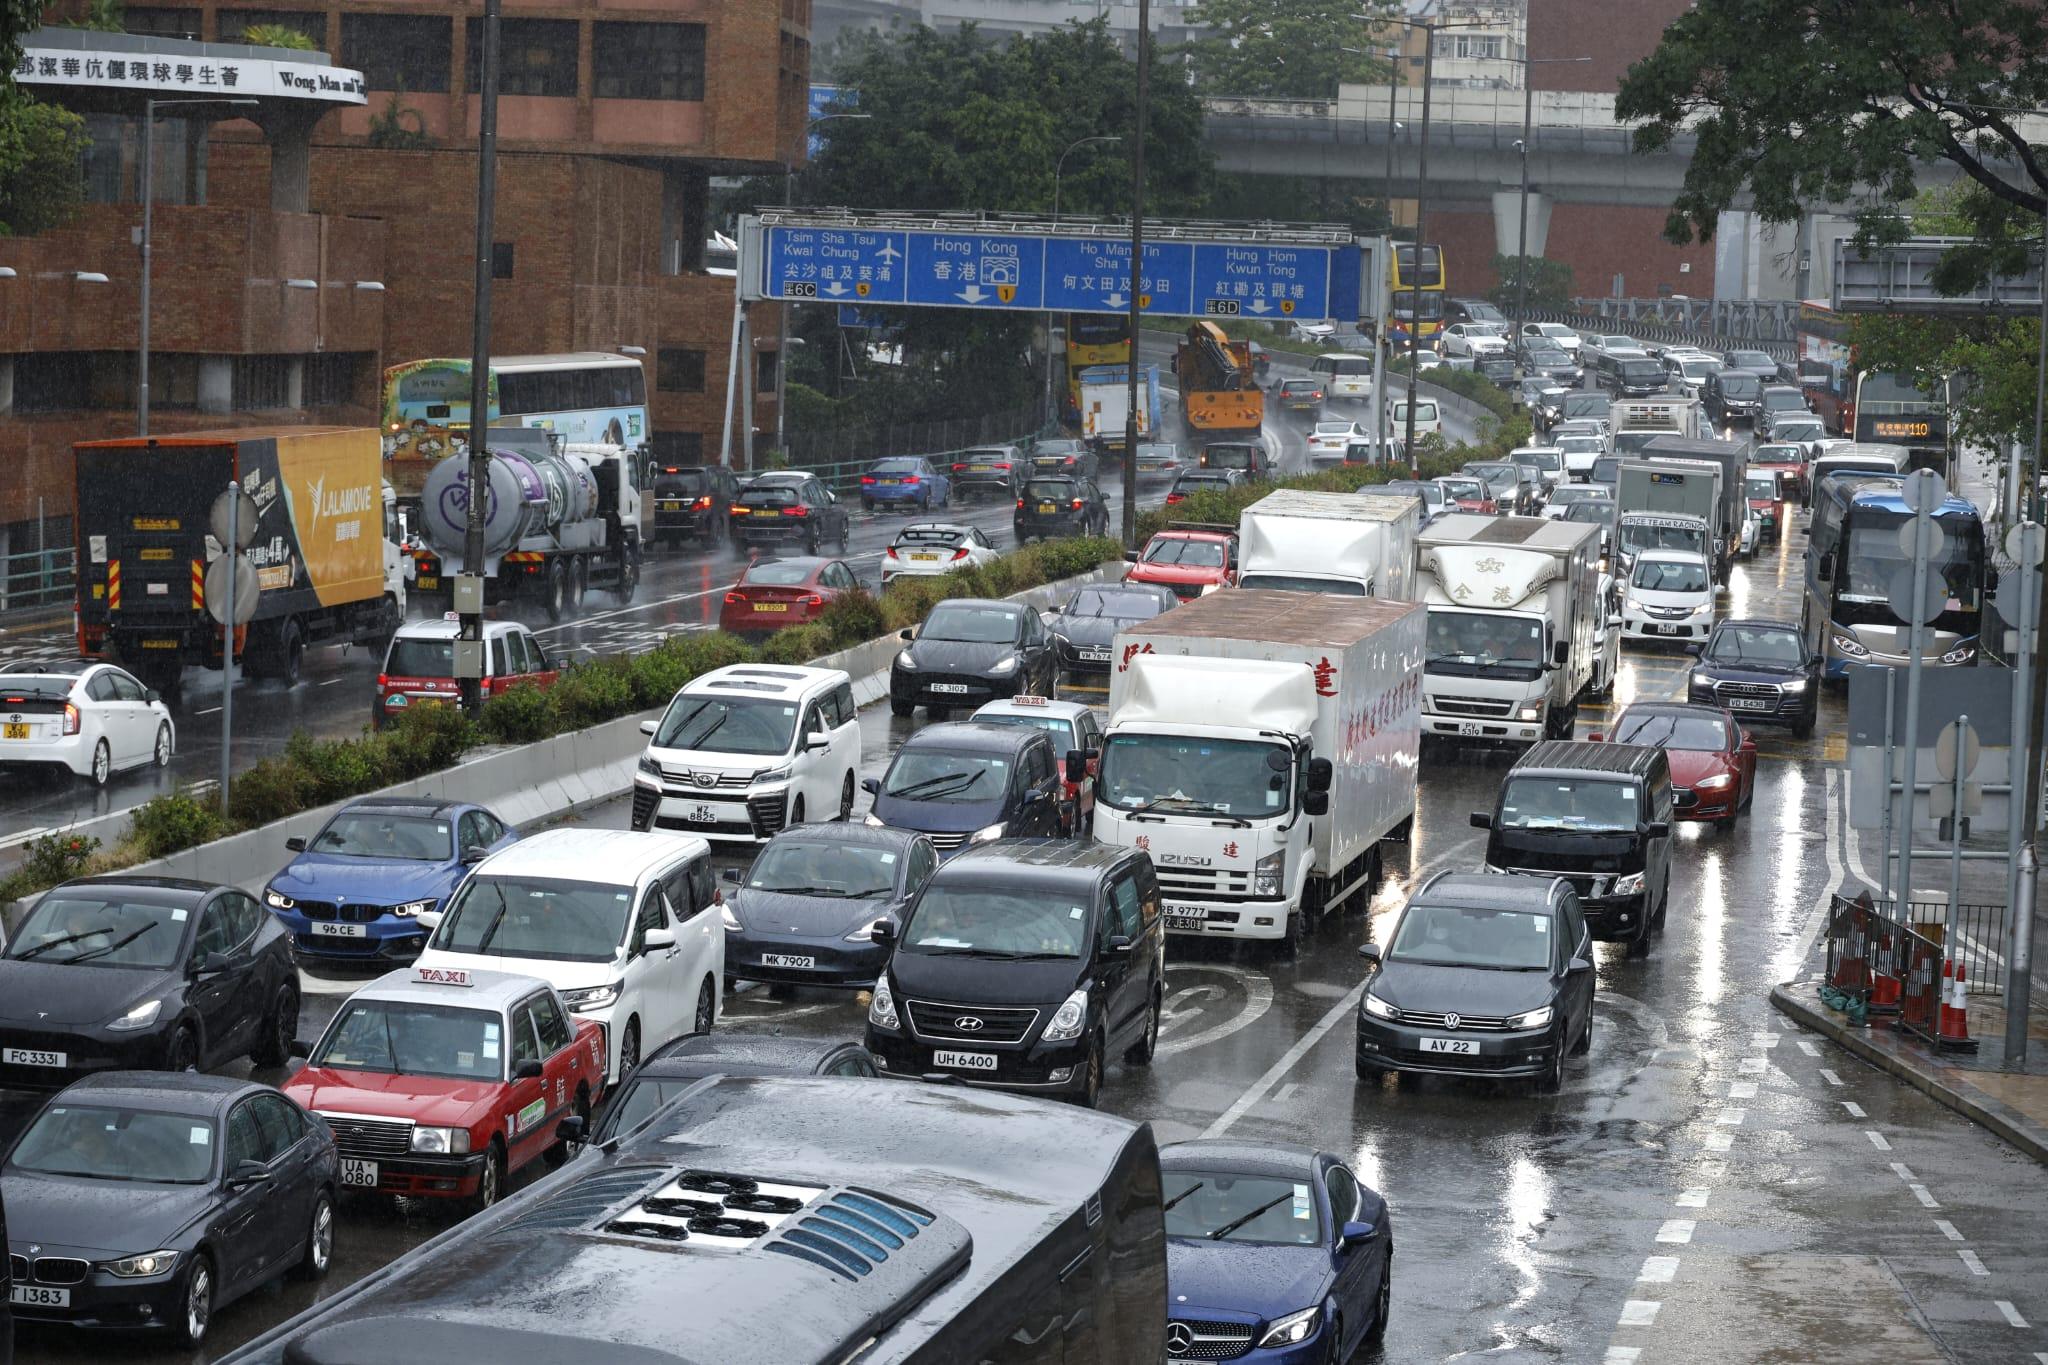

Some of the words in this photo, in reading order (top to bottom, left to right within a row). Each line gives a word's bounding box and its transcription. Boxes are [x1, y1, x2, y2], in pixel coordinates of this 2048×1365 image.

[279, 71, 316, 93] Wong
[319, 75, 341, 92] Man
[784, 230, 814, 243] Tsim
[821, 232, 845, 245] Sha
[852, 233, 876, 246] Tsui
[784, 244, 813, 257] Kwai
[821, 246, 860, 261] Chung
[933, 237, 971, 255] Hong
[981, 240, 1018, 257] Kong
[1080, 242, 1098, 255] Ho
[1105, 243, 1132, 256] Man
[1143, 245, 1160, 257] Tin
[1095, 256, 1119, 269] Sha
[1226, 248, 1258, 264] Hung
[1268, 250, 1296, 262] Hom
[933, 261, 976, 280] 香港
[1226, 262, 1261, 275] Kwun
[1266, 264, 1296, 279] Tong
[795, 283, 815, 297] 6C
[860, 283, 867, 295] 5
[1063, 274, 1170, 293] 何文田及沙田
[1003, 288, 1009, 300] 1
[1217, 300, 1239, 314] 6D
[1284, 302, 1291, 312] 5
[1909, 423, 1928, 436] 110
[322, 485, 372, 517] LALAMOVE
[1649, 519, 1672, 528] TEAM
[1673, 520, 1704, 530] RACING
[933, 684, 944, 692] EC
[949, 685, 966, 693] 3102
[1014, 696, 1046, 705] TAXI
[1461, 728, 1479, 736] 5319
[1465, 722, 1476, 730] PV
[697, 805, 709, 814] WZ
[690, 813, 715, 822] 8825
[1178, 906, 1206, 917] 9777
[322, 924, 337, 934] 96
[339, 926, 355, 936] CE
[766, 955, 781, 966] MK
[783, 956, 811, 967] 7902
[419, 968, 466, 983] TAXI
[1430, 1041, 1447, 1051] AV
[1452, 1042, 1470, 1053] 22
[11, 1050, 27, 1062] FC
[29, 1052, 58, 1065] 3331
[937, 1053, 955, 1065] UH
[958, 1055, 993, 1068] 6400
[345, 1159, 365, 1173] UA
[340, 1172, 374, 1185] 080
[23, 1288, 62, 1304] 1383
